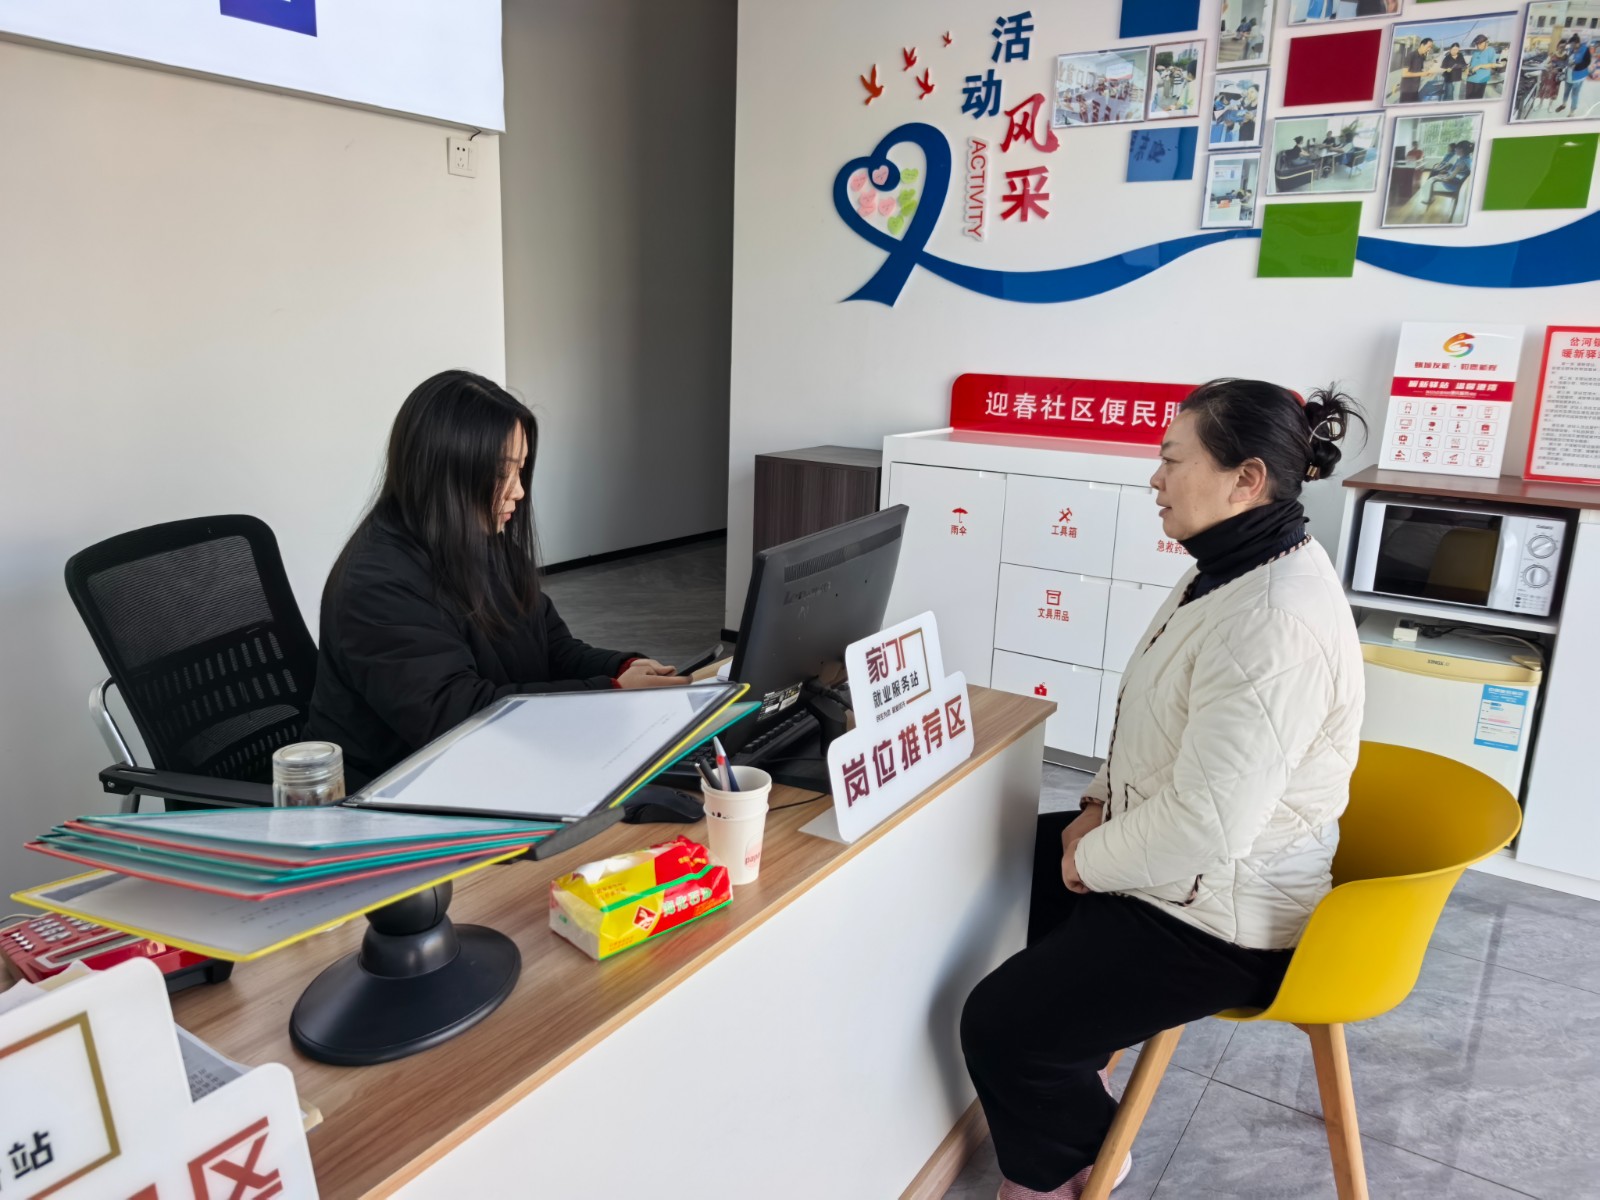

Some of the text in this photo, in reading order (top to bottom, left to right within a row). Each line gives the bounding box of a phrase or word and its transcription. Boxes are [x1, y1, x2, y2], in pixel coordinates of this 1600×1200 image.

[961, 10, 1035, 119] 活动
[999, 92, 1061, 223] 风采
[966, 139, 987, 238] ACTIVITY
[1561, 348, 1600, 359] 暖新驿
[950, 525, 967, 536] 雨伞
[1051, 525, 1077, 539] 工具箱
[1037, 608, 1070, 622] 文具用品
[872, 670, 919, 708] 就业服务站
[841, 694, 966, 808] 岗位推荐区
[126, 1116, 283, 1200] 区
